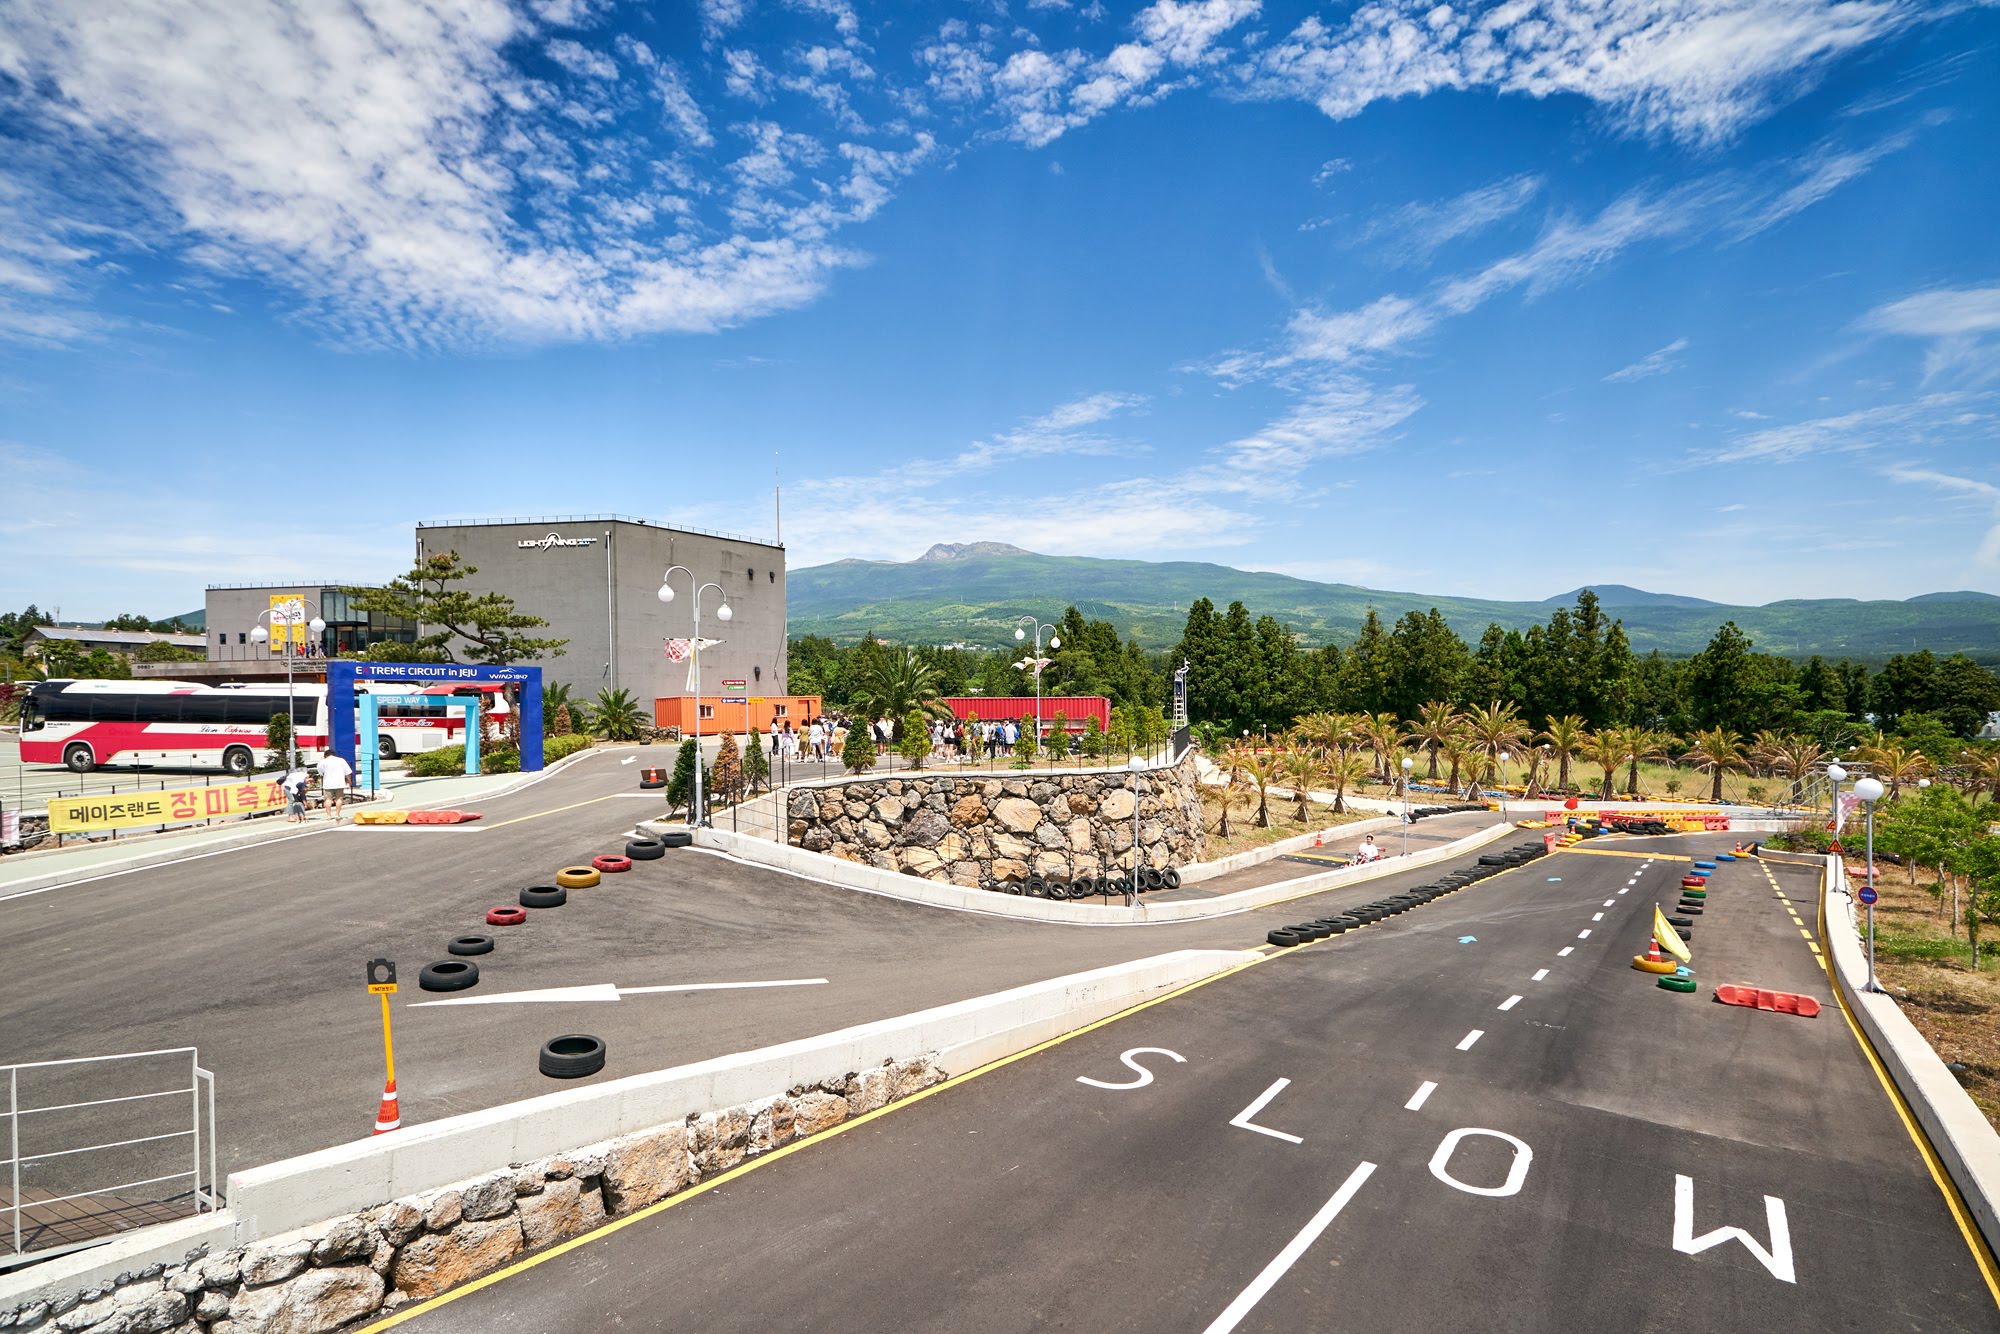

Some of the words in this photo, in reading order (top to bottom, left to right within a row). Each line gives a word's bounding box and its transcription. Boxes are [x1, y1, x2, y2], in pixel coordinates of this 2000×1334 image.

[518, 536, 577, 549] LIGHTNING
[355, 666, 406, 675] EXTREME
[407, 667, 446, 676] CIRCUIT
[448, 668, 457, 676] in
[459, 668, 477, 678] JEJU
[376, 696, 402, 704] SPEED
[403, 696, 420, 704] WAY
[69, 801, 162, 823] 메이즈랜드
